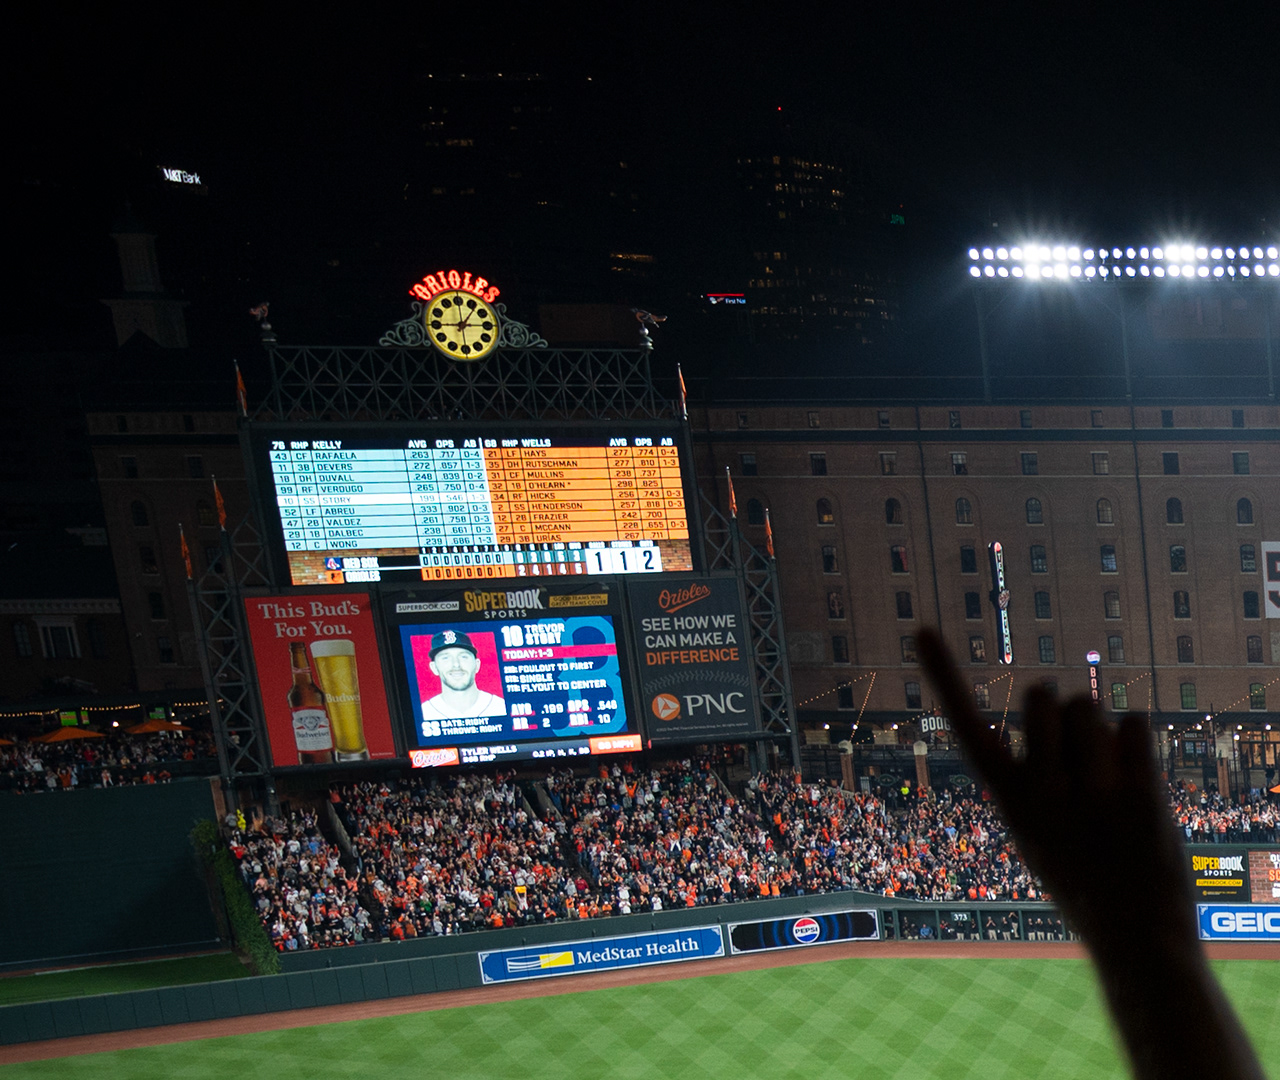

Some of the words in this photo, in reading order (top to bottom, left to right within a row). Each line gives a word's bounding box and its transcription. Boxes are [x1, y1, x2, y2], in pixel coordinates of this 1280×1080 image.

[183, 171, 201, 184] Bank
[313, 441, 341, 450] KELLY
[408, 440, 427, 448] AVG
[436, 440, 454, 448] OPS
[464, 440, 476, 448] AB
[522, 439, 551, 447] WELLS
[610, 439, 627, 447] AVG
[635, 438, 652, 446] OPS
[661, 438, 673, 446] AB
[328, 529, 364, 537] DALBEC
[594, 552, 603, 572] 1
[619, 551, 628, 570] 1
[643, 550, 654, 570] 2
[464, 589, 543, 612] SUPERBOOK
[658, 583, 711, 611] Orioles
[258, 602, 305, 619] This
[310, 601, 360, 617] Bud's
[398, 602, 458, 611] SUPERBOOK.COM
[485, 610, 527, 619] SPORTS
[525, 623, 565, 633] TREVOR
[642, 617, 671, 631] SEE
[674, 616, 708, 630] HOW
[712, 614, 736, 628] WE
[274, 622, 306, 638] For
[310, 621, 352, 636] You.
[501, 625, 524, 647] 10
[525, 633, 561, 645] STORY
[645, 634, 676, 648] CAN
[680, 632, 723, 646] MAKE
[726, 632, 736, 644] A
[646, 648, 739, 665] DIFFERENCE
[519, 664, 555, 673] FOULOUT
[557, 663, 568, 671] TO
[570, 662, 594, 670] FIRST
[520, 673, 553, 683] SINGLE
[521, 682, 555, 692] FLYOUT
[557, 682, 569, 690] TO
[571, 679, 606, 689] CENTER
[683, 692, 746, 716] PNC
[466, 718, 489, 726] RIGHT
[480, 725, 502, 733] RIGHT
[1192, 856, 1243, 871] SUPERBOOK
[953, 913, 968, 921] 373
[794, 926, 818, 936] PEPSI
[577, 945, 643, 965] MedStar
[645, 936, 699, 957] Health
